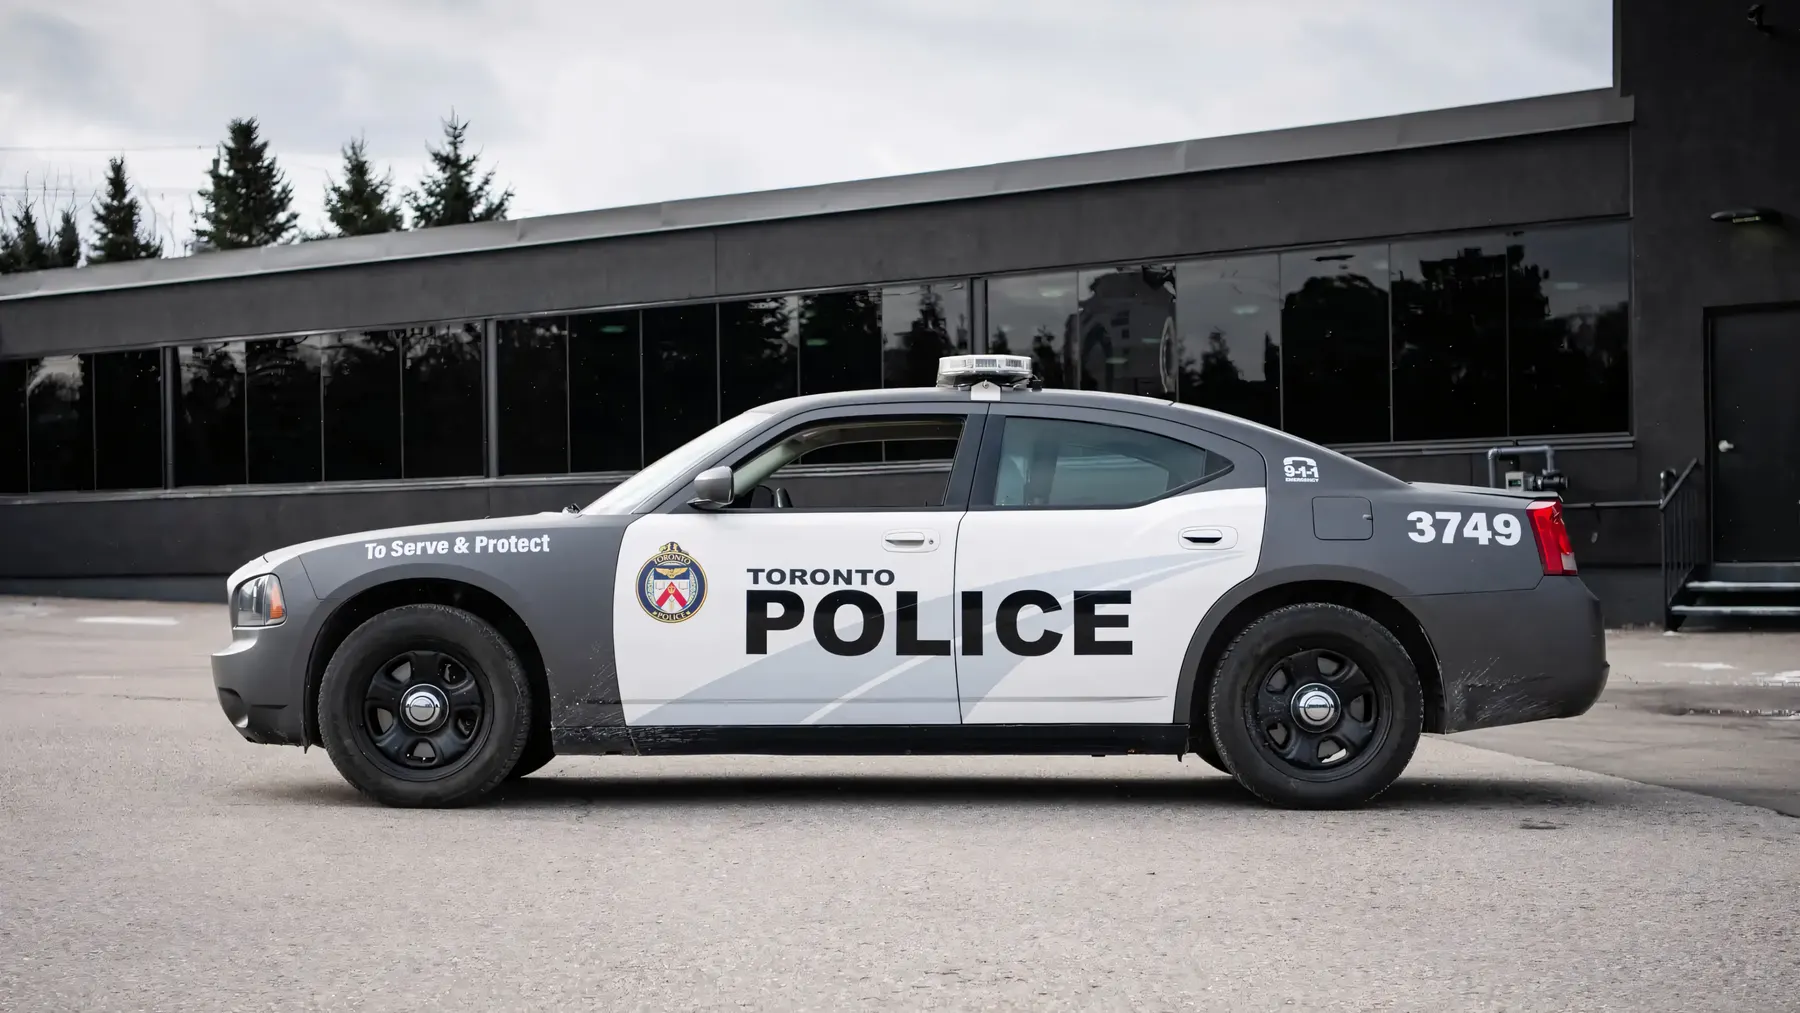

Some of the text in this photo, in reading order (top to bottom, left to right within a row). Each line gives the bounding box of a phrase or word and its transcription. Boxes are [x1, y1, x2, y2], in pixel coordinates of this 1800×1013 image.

[1284, 465, 1319, 477] 9-1-1
[1406, 510, 1522, 546] 3749
[364, 534, 551, 560] To Serve & Protect
[654, 553, 692, 565] TORONTO
[746, 568, 895, 586] TORONTO
[657, 611, 687, 621] POLICE
[746, 589, 1133, 657] POLICE
